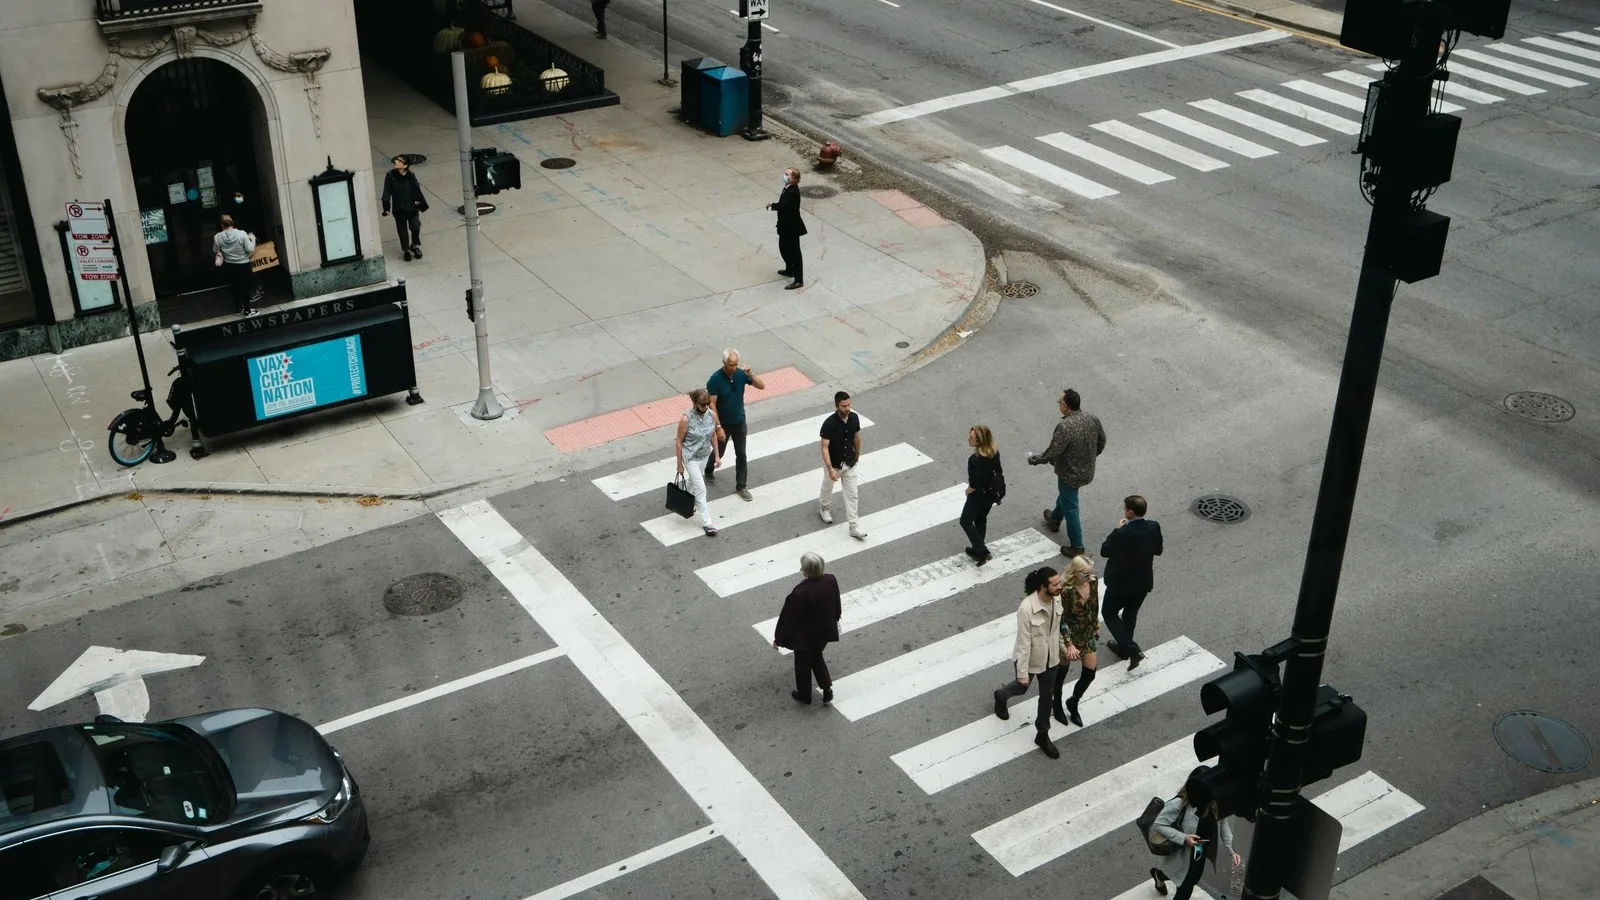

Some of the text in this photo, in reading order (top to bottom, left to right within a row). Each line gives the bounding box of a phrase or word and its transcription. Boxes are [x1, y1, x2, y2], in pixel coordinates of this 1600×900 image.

[251, 256, 268, 268] NIKE
[222, 299, 355, 336] NEWSPAPERS
[258, 354, 286, 374] VAX
[345, 336, 361, 395] #PROTECTCHICAGO
[264, 380, 313, 404] NATION
